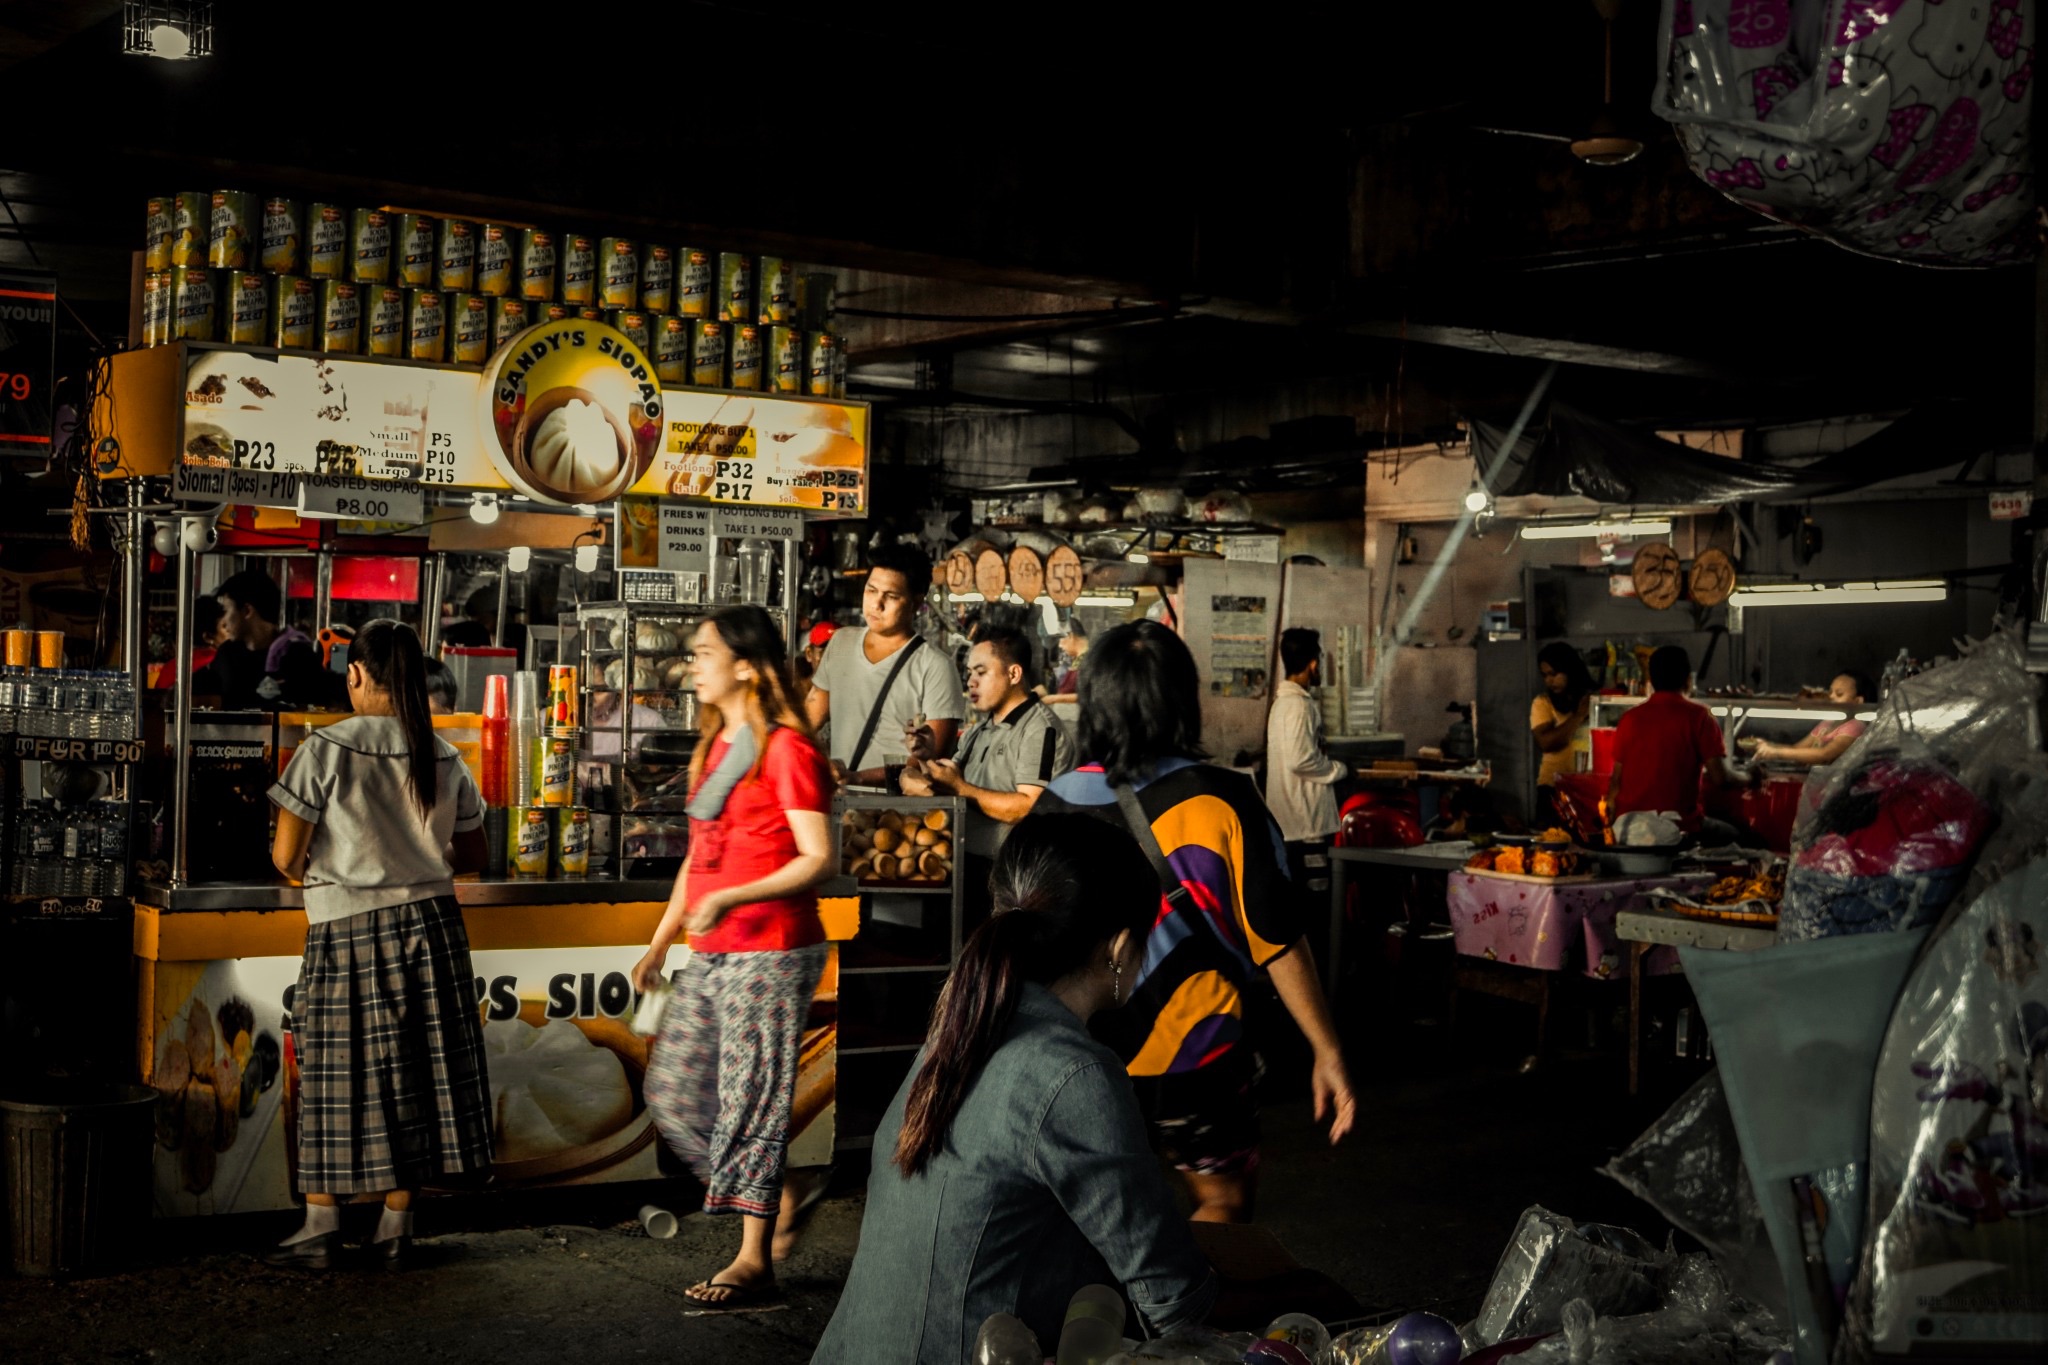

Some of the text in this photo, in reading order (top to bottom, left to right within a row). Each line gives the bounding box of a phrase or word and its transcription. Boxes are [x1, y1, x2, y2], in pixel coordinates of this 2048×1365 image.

[0, 305, 51, 323] YOU!!
[500, 331, 660, 418] SANDY'S SIOPAO
[186, 392, 223, 404] Asado
[672, 423, 725, 436] FOOTLONG
[727, 427, 747, 437] BUY
[432, 433, 451, 447] P5
[678, 441, 703, 452] TAKE
[233, 440, 275, 470] P23
[427, 450, 455, 465] P10
[368, 465, 454, 483] Large P15
[716, 461, 753, 479] P32
[178, 465, 225, 494] Siomai
[270, 475, 296, 499] P10
[305, 474, 420, 494] TOASTED SIOPAO
[767, 477, 783, 487] Buy
[715, 482, 752, 500] P17
[664, 509, 693, 519] FRIES
[718, 506, 769, 518] FOOTLONG
[772, 508, 793, 519] BUY
[666, 526, 705, 536] DRINKS
[725, 524, 748, 534] TAKE
